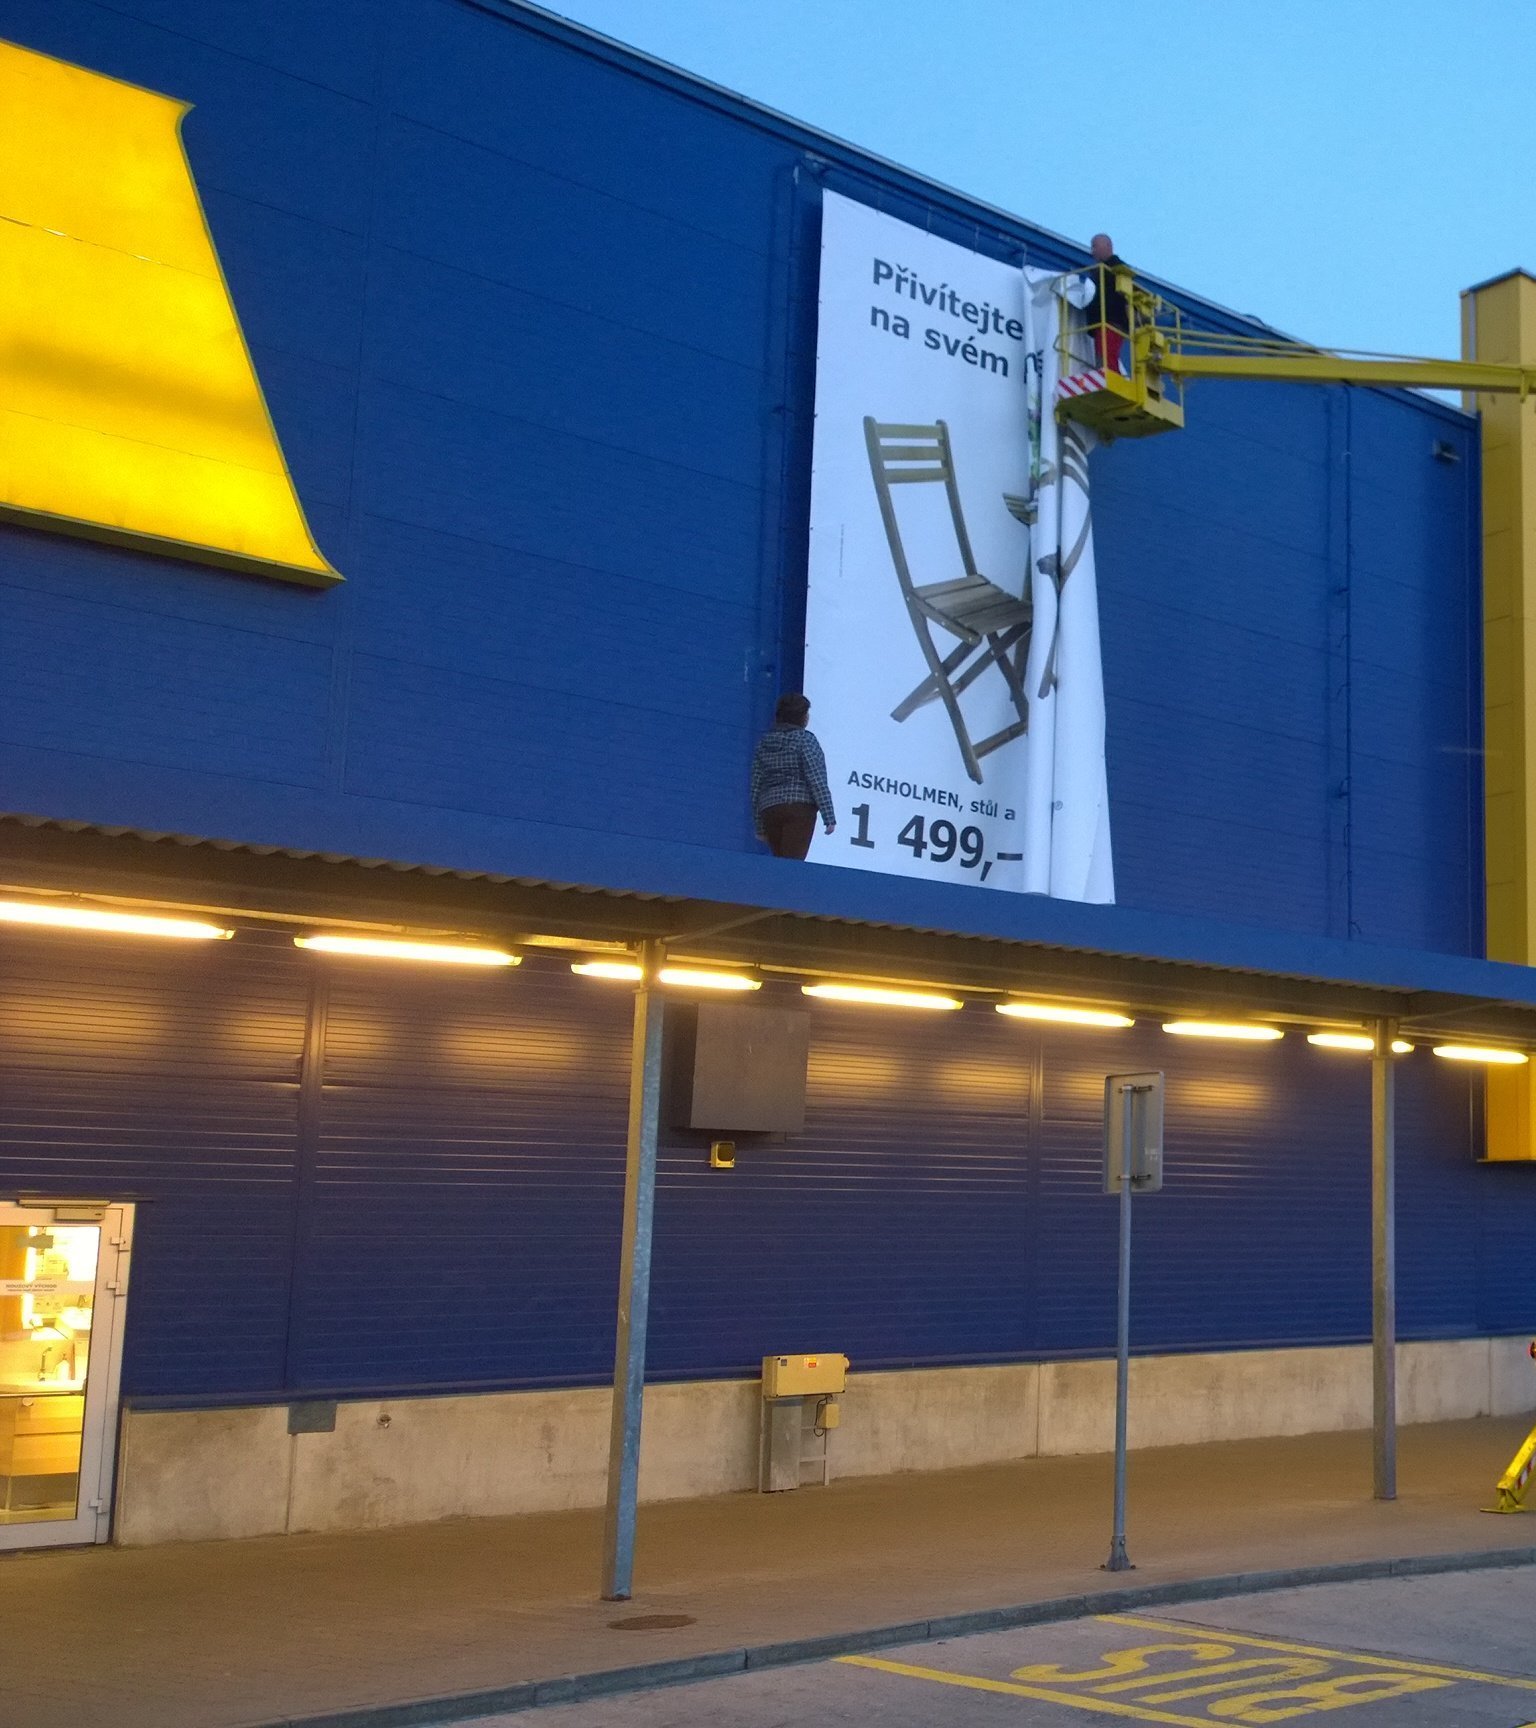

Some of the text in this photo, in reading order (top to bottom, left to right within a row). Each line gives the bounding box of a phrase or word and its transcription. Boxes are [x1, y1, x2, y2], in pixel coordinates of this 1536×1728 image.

[872, 256, 1024, 342] Přivítejte
[870, 305, 910, 340] na
[924, 327, 1009, 378] svém
[847, 770, 1016, 821] ASKHOLMEN, stůl a
[850, 803, 875, 850] 1
[1009, 1642, 1460, 1724] BUS
